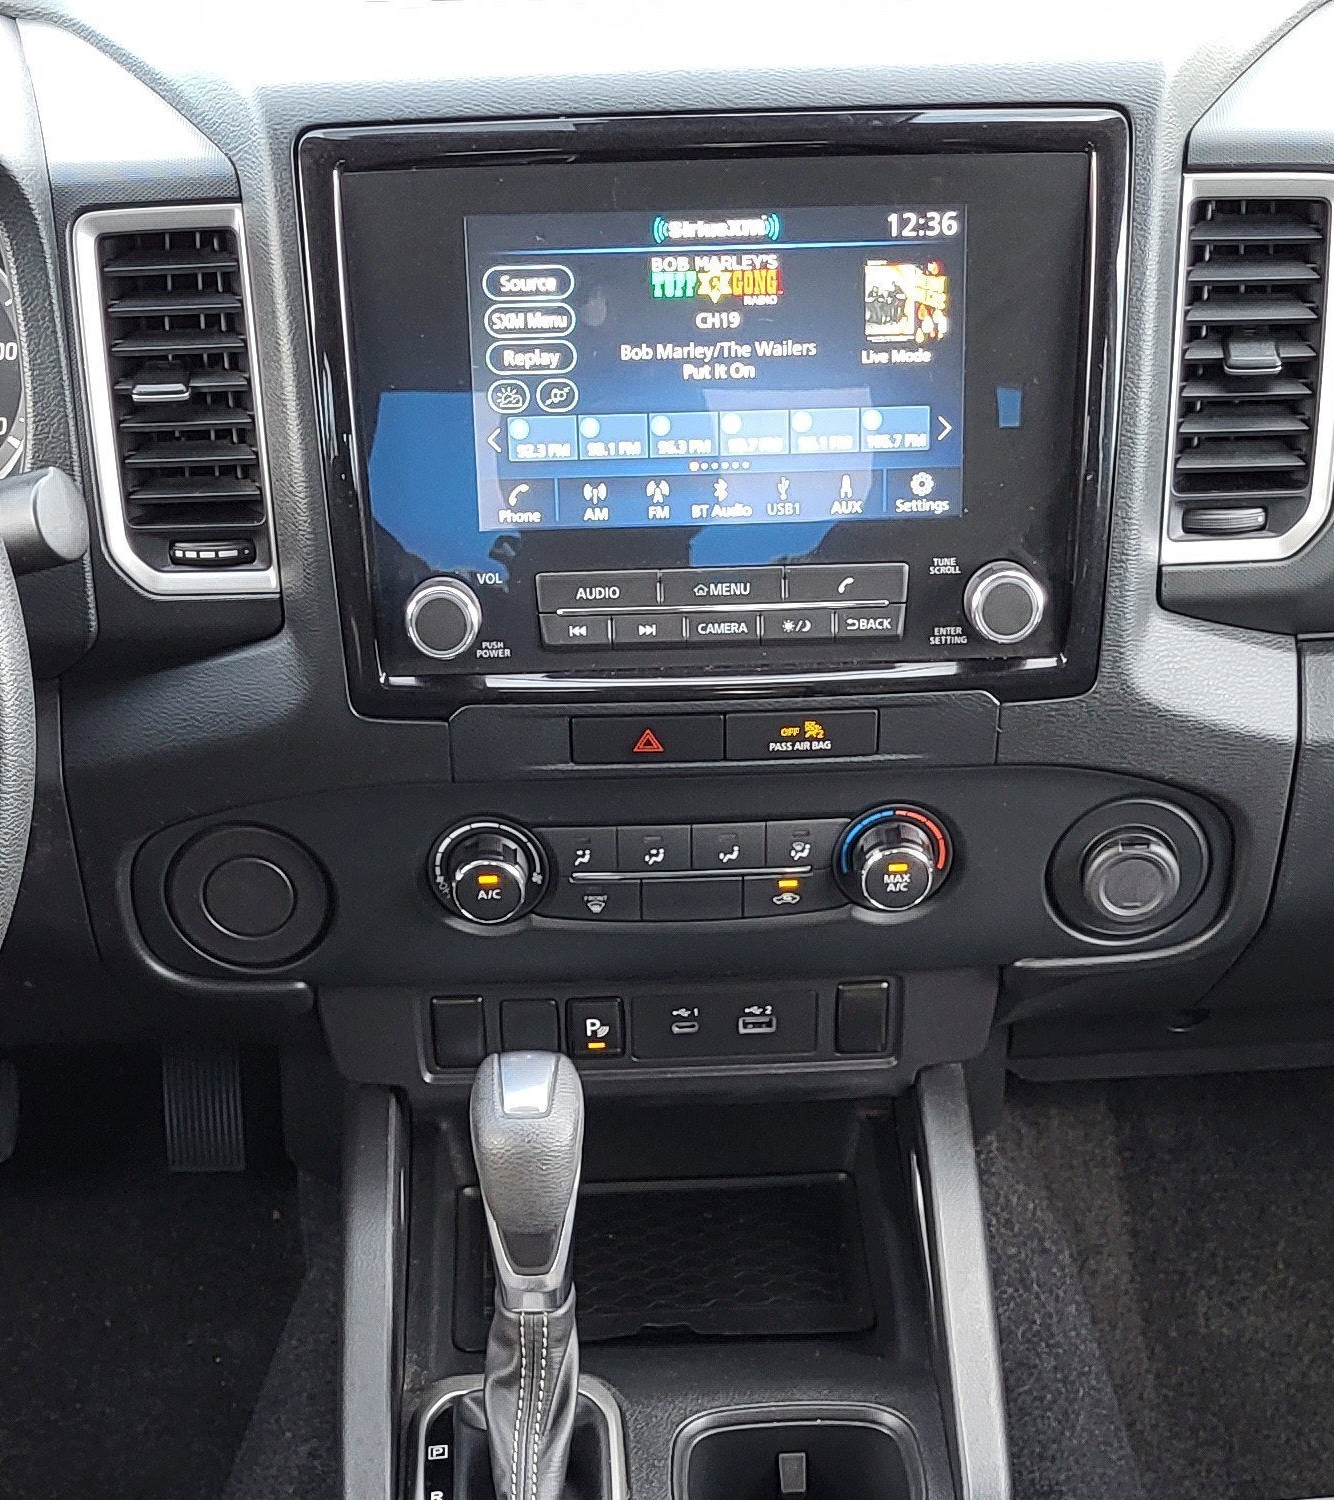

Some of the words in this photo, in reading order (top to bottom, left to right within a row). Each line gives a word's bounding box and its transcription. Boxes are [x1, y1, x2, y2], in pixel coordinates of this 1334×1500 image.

[887, 211, 958, 237] 12:36
[650, 257, 689, 272] BOB
[694, 253, 779, 271] MARLEY'S
[499, 275, 557, 293] Source
[732, 269, 777, 295] GONG
[491, 313, 525, 330] SXM
[527, 312, 568, 329] Menu
[696, 311, 741, 329] CH19
[620, 344, 654, 361] Bob
[656, 341, 752, 362] Marley/The
[755, 340, 817, 357] Wailers
[861, 350, 889, 364] Live
[892, 349, 933, 363] Mode
[503, 350, 561, 369] Replay
[683, 364, 712, 380] Put
[729, 362, 756, 379] On
[648, 505, 670, 520] FM
[692, 504, 709, 519] BT
[767, 502, 800, 516] USB1
[830, 500, 863, 515] AUX
[895, 498, 950, 514] Settings
[498, 509, 542, 524] Phone
[583, 507, 609, 521] AM
[932, 557, 956, 566] TUNE
[929, 565, 961, 575] SCROLL
[477, 573, 503, 585] VOL
[575, 587, 620, 600] AUDIO
[709, 582, 751, 596] MENU
[697, 622, 748, 635] CAMERA
[859, 618, 892, 630] BACK
[934, 627, 963, 636] ENTER
[482, 641, 504, 649] PUSH
[929, 635, 967, 646] SETTING
[476, 648, 511, 659] POWER
[769, 742, 793, 751] PASS
[793, 741, 811, 751] AIR
[811, 740, 832, 750] BAG
[883, 873, 911, 884] MAX
[886, 882, 909, 892] A/C
[477, 889, 502, 900] A/C
